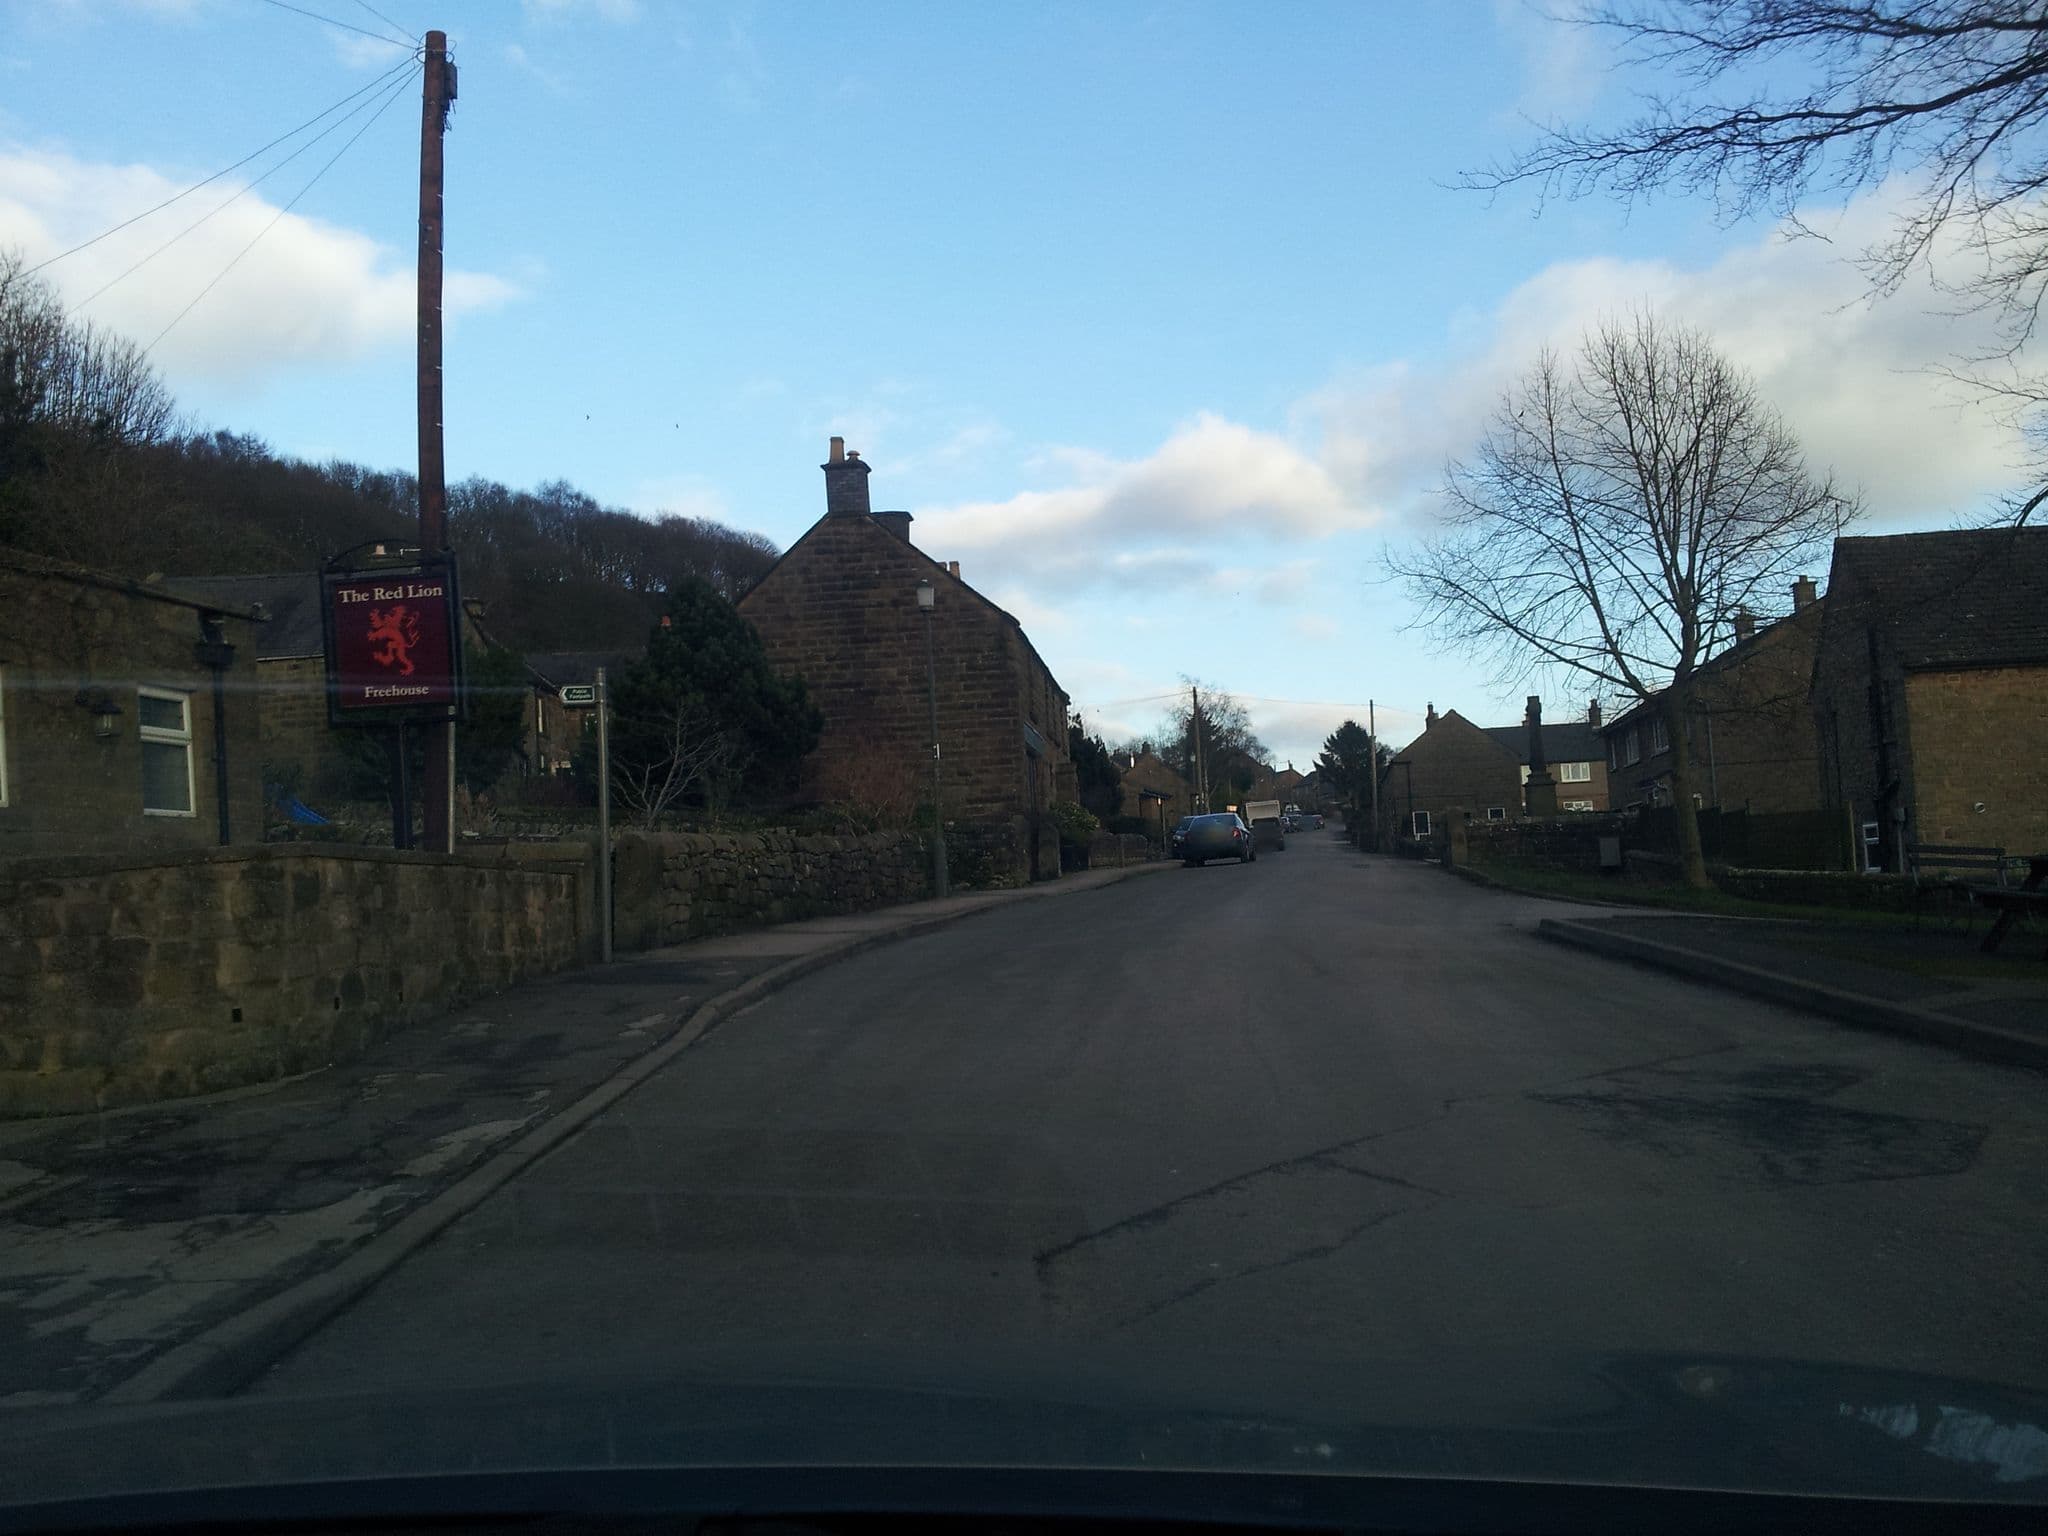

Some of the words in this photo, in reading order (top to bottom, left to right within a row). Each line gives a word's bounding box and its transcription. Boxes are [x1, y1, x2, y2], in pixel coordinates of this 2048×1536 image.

[338, 589, 370, 603] The
[373, 587, 403, 601] Red
[407, 584, 443, 599] Lion
[364, 684, 430, 698] Freehouse
